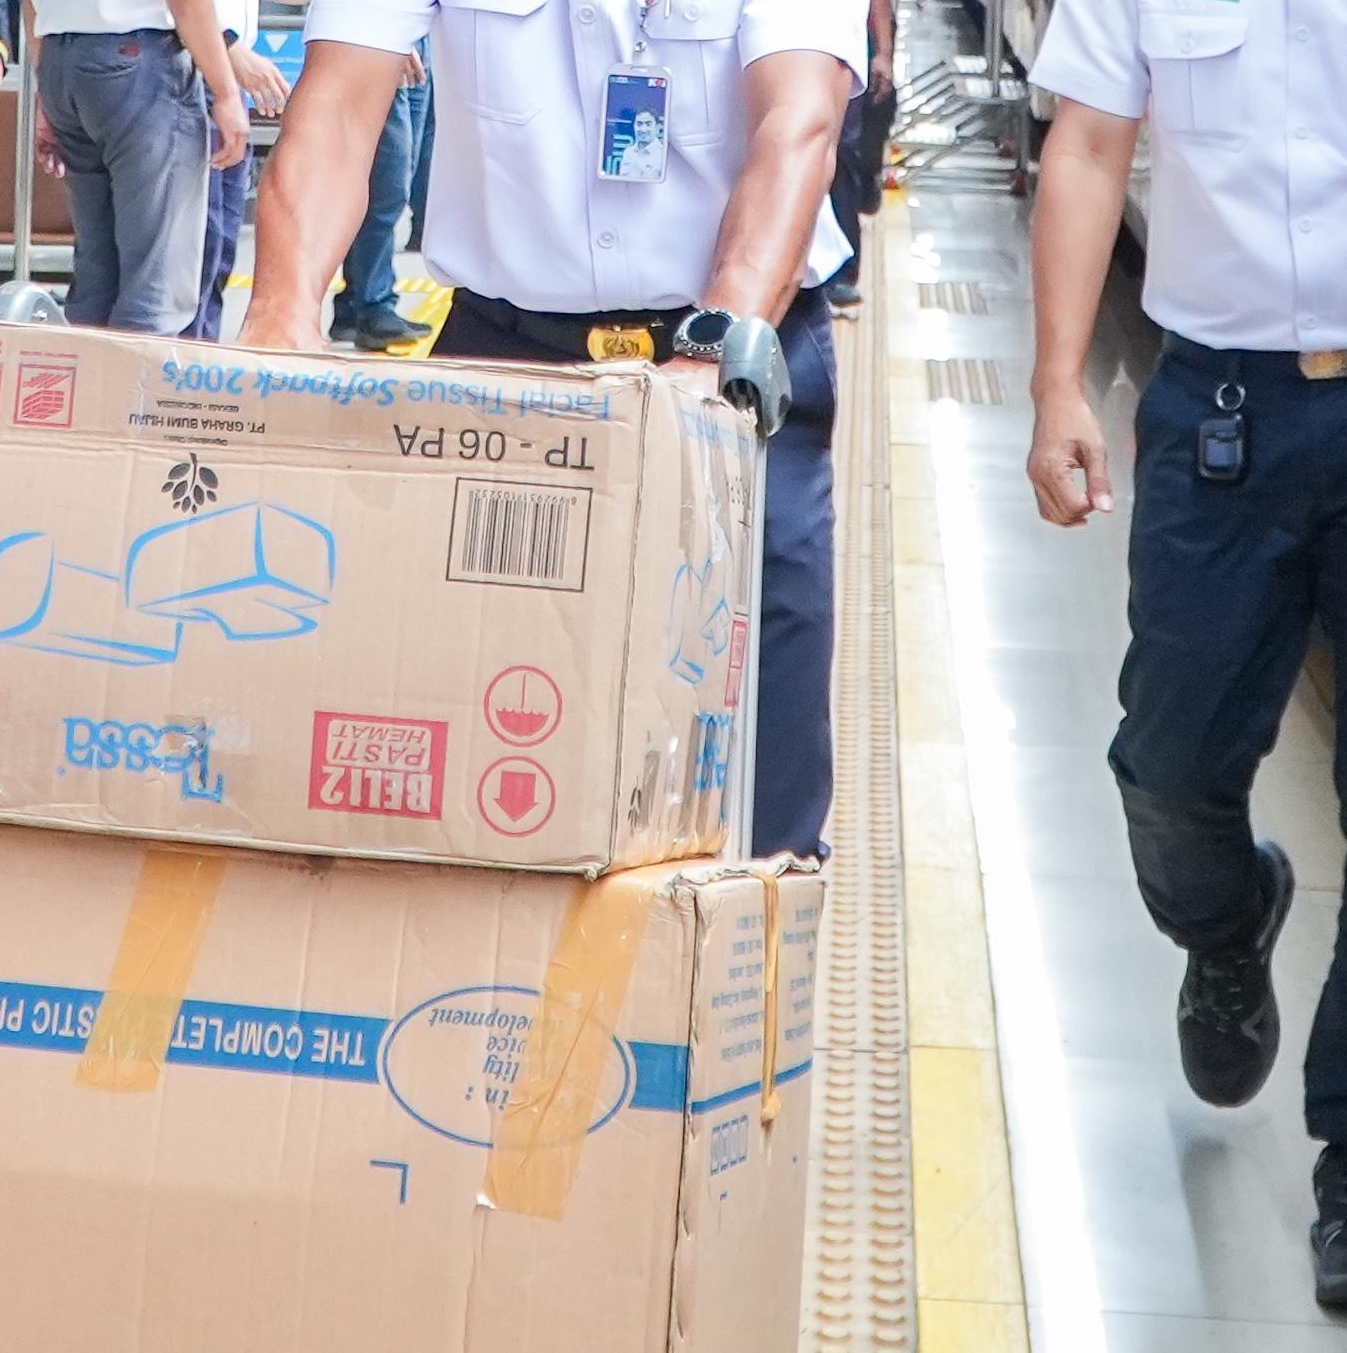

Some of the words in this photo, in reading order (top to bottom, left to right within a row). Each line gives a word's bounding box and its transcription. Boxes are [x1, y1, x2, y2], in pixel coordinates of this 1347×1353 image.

[162, 359, 244, 397] 200's
[254, 368, 399, 409] Softpack
[406, 381, 511, 415] Tissue
[519, 389, 612, 421] Facial
[128, 413, 165, 428] HIJAU
[166, 416, 199, 430] BUMI
[200, 418, 245, 433] GRAHA
[247, 421, 266, 434] PT.
[393, 423, 444, 459] PA
[458, 429, 507, 463] 06
[544, 436, 595, 472] TP
[332, 724, 426, 744] HEMAT
[62, 717, 225, 804] Tessa
[332, 741, 426, 767] PASTI
[32, 999, 96, 1041] STIC
[169, 1012, 304, 1061] COMPLET
[309, 1027, 366, 1066] THE
[482, 1054, 520, 1084] lity
